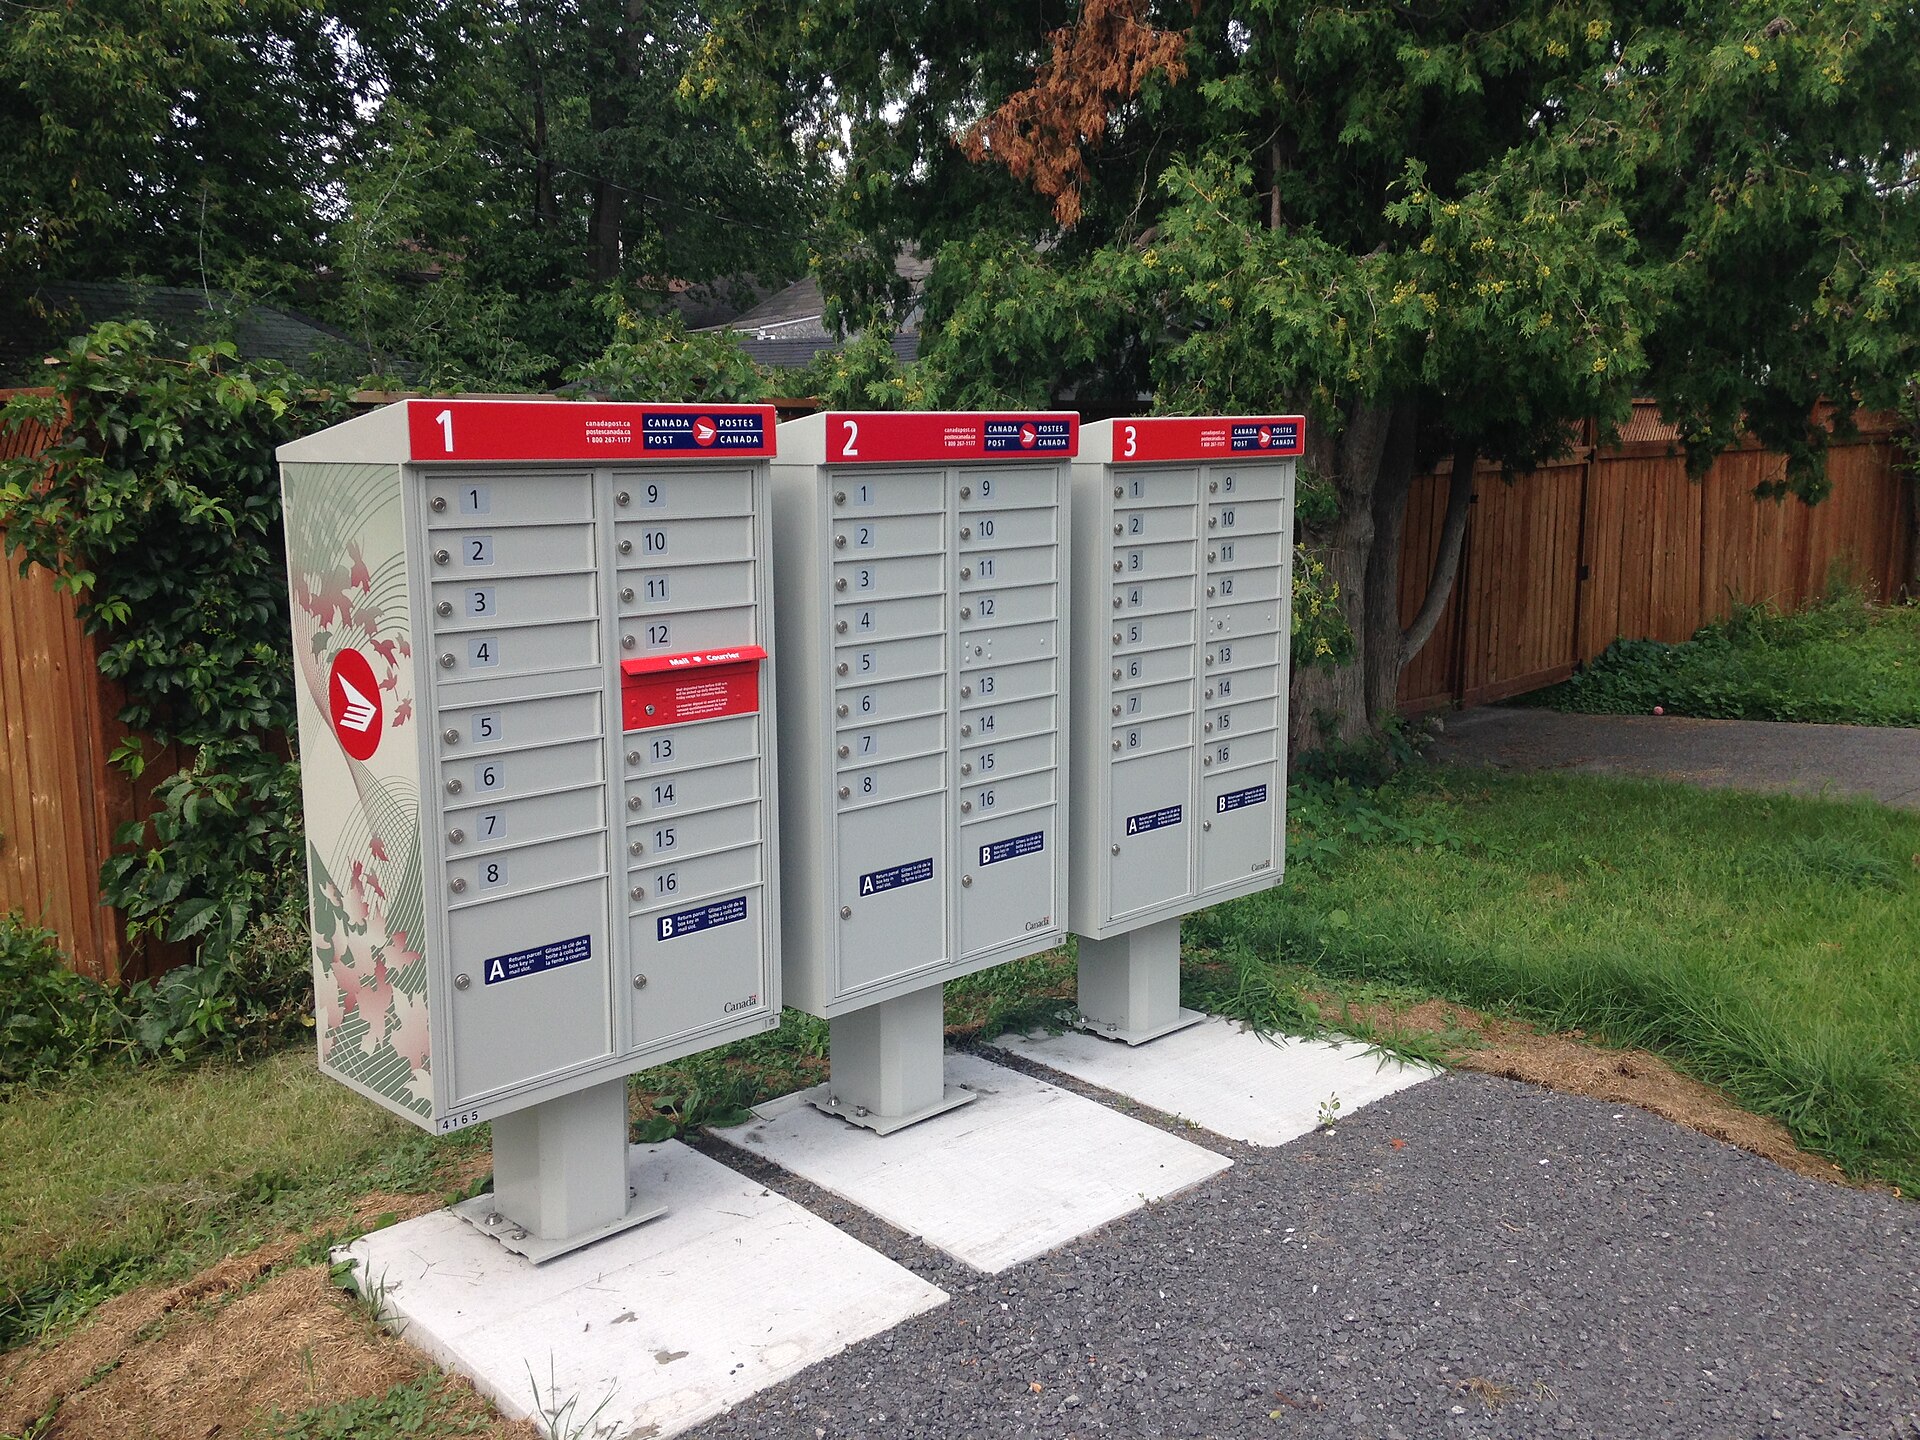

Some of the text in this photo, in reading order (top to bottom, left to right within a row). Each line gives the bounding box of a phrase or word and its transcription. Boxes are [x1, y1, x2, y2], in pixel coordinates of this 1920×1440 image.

[435, 409, 454, 452] 1
[585, 420, 631, 428] canadapost.ca
[647, 419, 690, 427] CANADA
[719, 419, 754, 427] POSTES
[648, 436, 674, 444] POST
[842, 420, 859, 456] 2
[1124, 426, 1137, 457] 3
[982, 481, 990, 496] 9
[1134, 482, 1138, 495] 1
[1226, 477, 1232, 490] 9
[470, 489, 478, 509] 1
[647, 485, 658, 503] 9
[861, 486, 867, 502] 1
[1132, 518, 1139, 533] 2
[1222, 512, 1234, 525] 10
[860, 528, 868, 545] 2
[979, 521, 993, 536] 10
[645, 532, 665, 550] 10
[472, 541, 484, 561] 2
[1222, 546, 1232, 559] 11
[980, 560, 992, 576] 11
[1132, 555, 1138, 569] 3
[861, 570, 869, 587] 3
[647, 579, 665, 598] 11
[1221, 580, 1232, 594] 12
[474, 593, 485, 611] 3
[1131, 591, 1138, 604] 4
[980, 599, 994, 615] 12
[861, 612, 870, 628] 4
[648, 625, 668, 644] 12
[1131, 626, 1137, 640] 5
[476, 643, 490, 661] 4
[669, 653, 740, 666] Mail Courrier
[1220, 648, 1231, 662] 13
[862, 654, 870, 670] 5
[1131, 662, 1137, 676] 6
[980, 677, 994, 693] 13
[1219, 681, 1230, 695] 14
[862, 695, 870, 711] 6
[1131, 698, 1137, 711] 7
[481, 718, 492, 737] 5
[980, 715, 994, 732] 14
[1219, 714, 1229, 728] 15
[863, 736, 871, 752] 7
[1130, 733, 1137, 746] 8
[653, 740, 672, 759] 13
[1218, 747, 1229, 761] 16
[980, 754, 994, 769] 15
[483, 767, 495, 786] 6
[863, 777, 872, 792] 8
[654, 784, 674, 803] 14
[980, 791, 994, 806] 16
[1219, 797, 1226, 811] B
[485, 816, 496, 834] 7
[1128, 818, 1137, 834] A
[656, 829, 675, 848] 15
[982, 847, 991, 863] B
[487, 864, 499, 882] 8
[657, 873, 676, 892] 16
[863, 876, 874, 894] A
[662, 918, 673, 937] B
[508, 951, 542, 963] Return parcel
[551, 956, 564, 965] fente
[489, 960, 505, 981] A
[724, 995, 757, 1013] Canada
[442, 1111, 478, 1129] 4165
